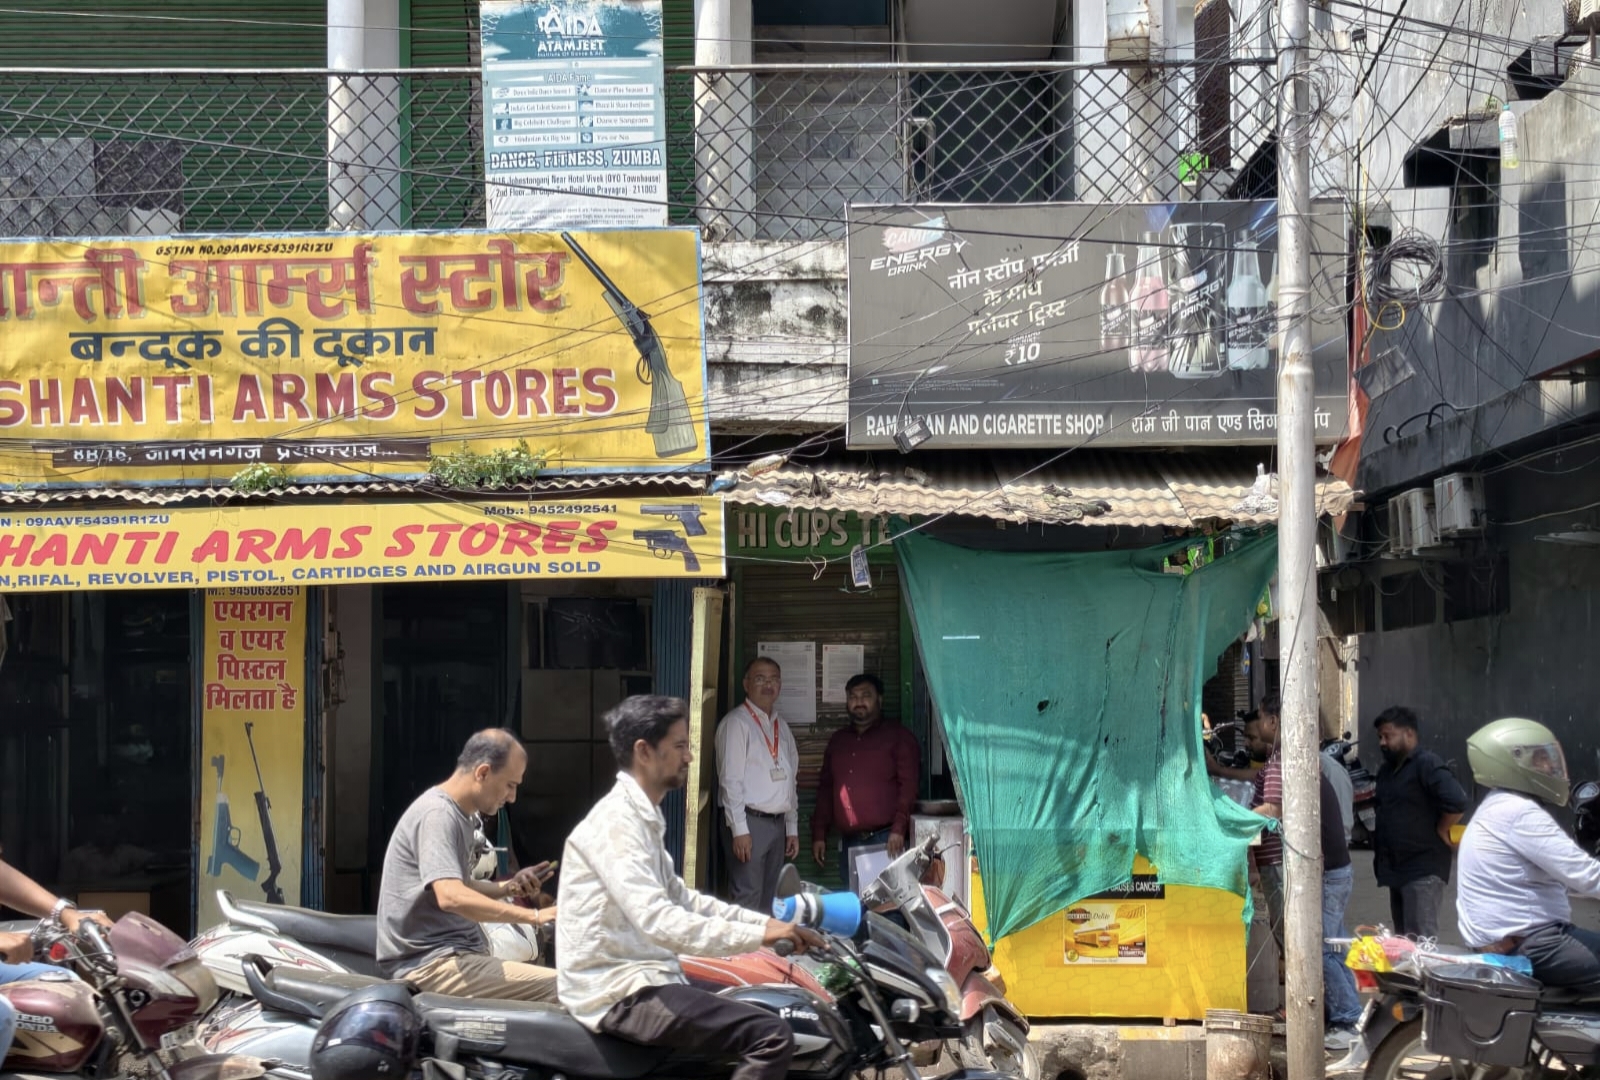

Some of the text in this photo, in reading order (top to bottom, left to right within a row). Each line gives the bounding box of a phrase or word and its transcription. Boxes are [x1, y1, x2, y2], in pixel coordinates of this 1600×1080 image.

[538, 6, 604, 37] AIDA
[537, 40, 606, 52] ATAMJEET
[490, 147, 662, 170] DANCE, FITNESS, ZUMBA
[156, 245, 195, 256] GSTIN
[870, 240, 967, 271] ENERGY
[400, 239, 571, 315] स्टोर
[888, 261, 928, 277] DRINK
[948, 268, 981, 289] नॉन
[984, 257, 1025, 282] स्टॉप
[69, 317, 438, 369] बन्दूक की दूकान
[0, 367, 619, 428] SHANTI ARMS STORES
[866, 414, 897, 436] RAM
[949, 414, 979, 435] AND
[984, 413, 1063, 435] CIGARETTE
[1066, 413, 1104, 435] SHOP
[1131, 415, 1157, 434] राम
[1161, 409, 1180, 432] जी
[1184, 414, 1213, 431] पान
[1216, 414, 1243, 433] एण्ड
[528, 504, 618, 515] 9452492541
[191, 525, 373, 564] ARMS
[384, 520, 618, 558] STORES
[738, 511, 893, 548] HI CUPS TE
[88, 571, 200, 586] REVOLVER,
[207, 569, 285, 584] PISTOL,
[292, 566, 407, 580] CARTIDGES
[414, 564, 456, 577] AND
[464, 562, 541, 576] AIRGUN
[548, 561, 601, 574] SOLD
[230, 586, 300, 596] 9450632651
[213, 601, 294, 622] एयरगन
[219, 630, 287, 651] व एयर
[217, 654, 287, 680] पिस्टल
[206, 683, 297, 710] मिलता है
[1135, 881, 1161, 892] CANCER
